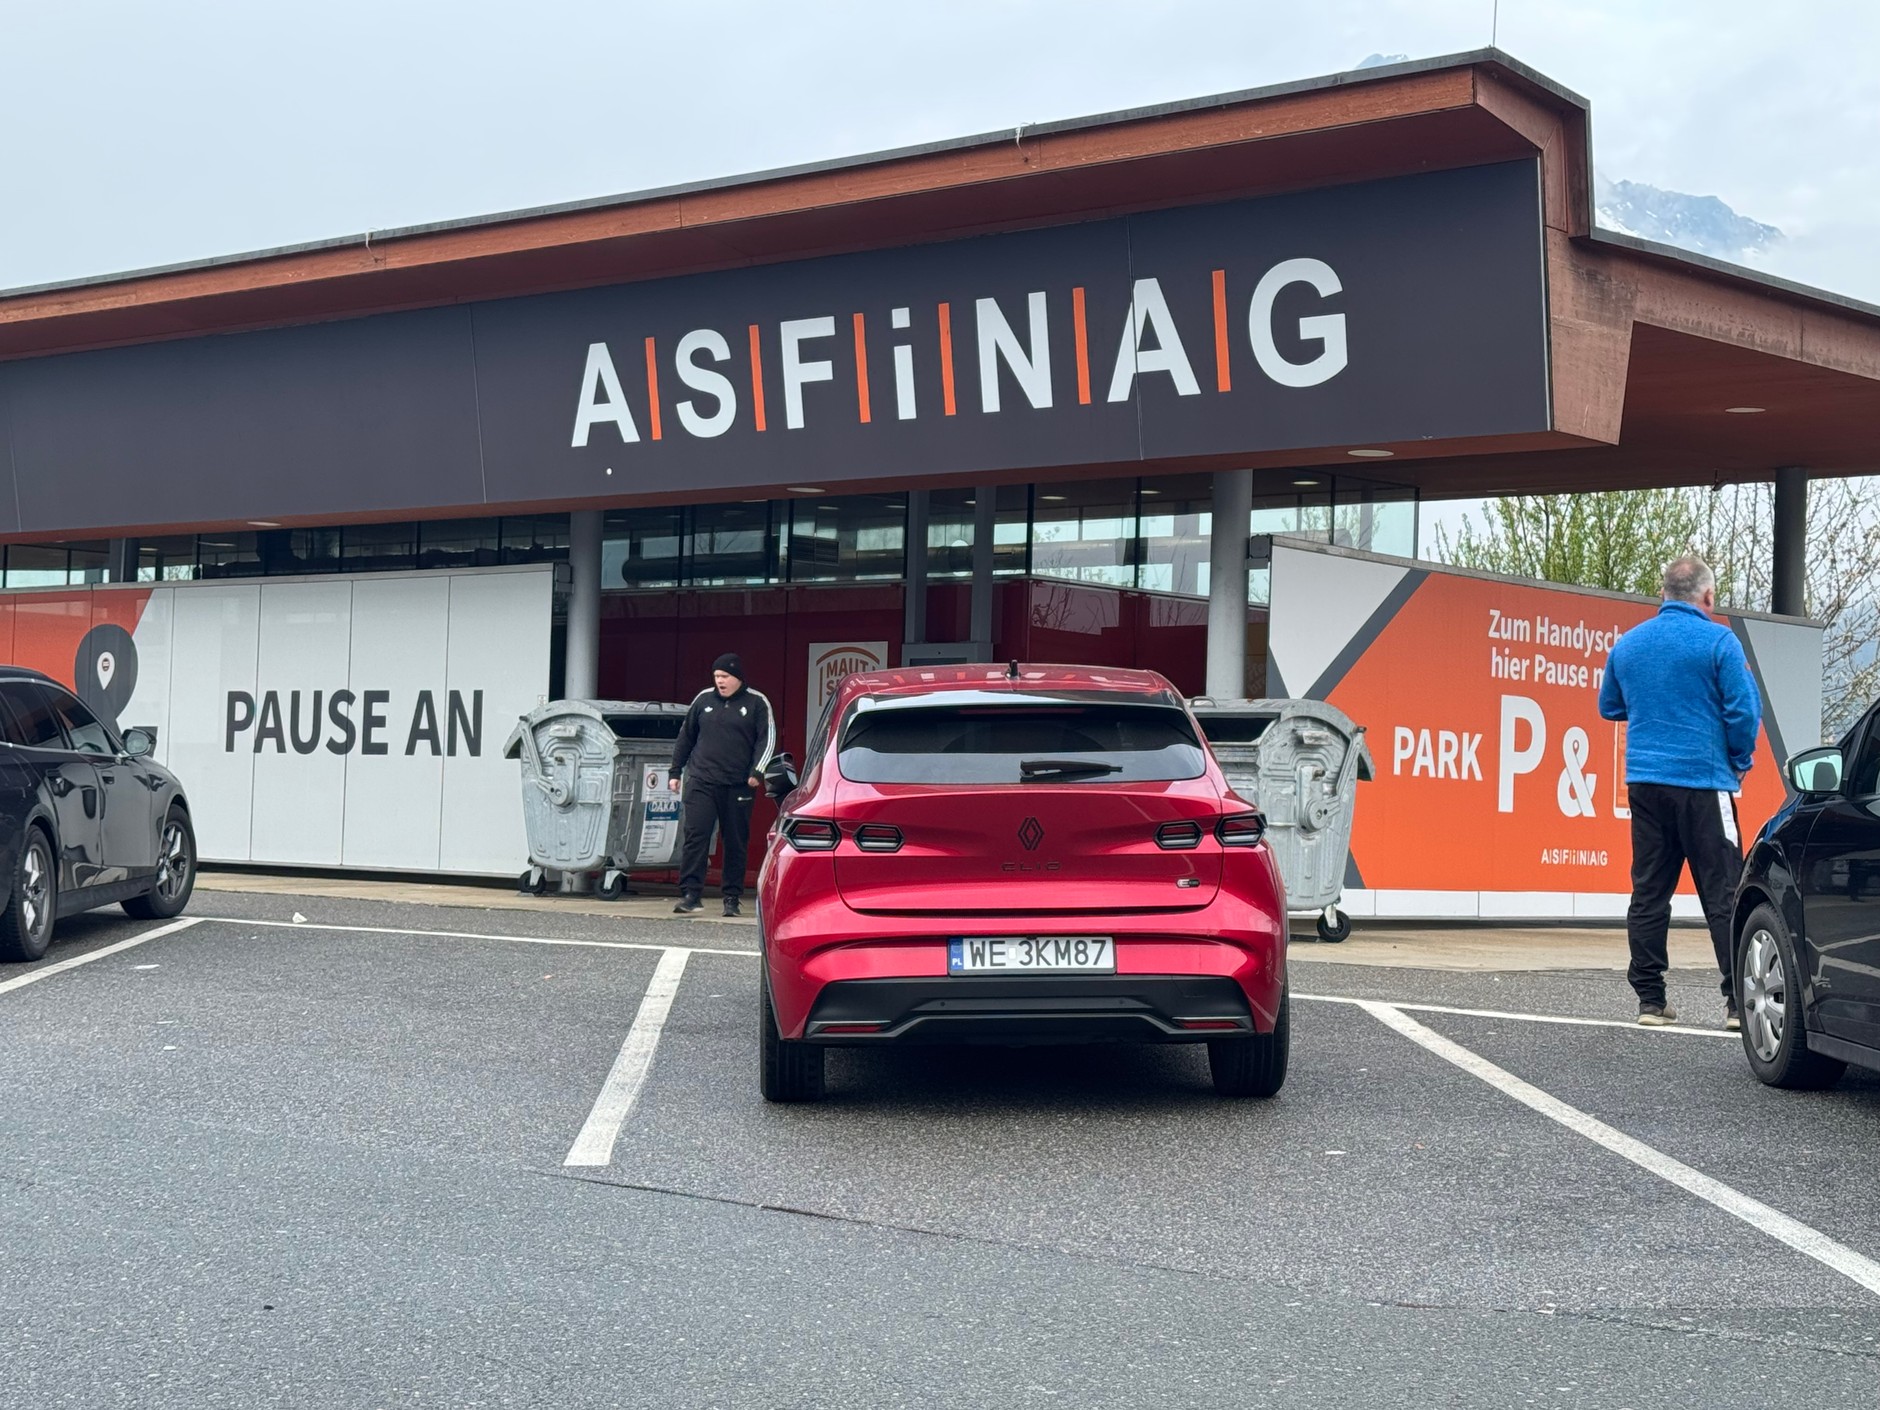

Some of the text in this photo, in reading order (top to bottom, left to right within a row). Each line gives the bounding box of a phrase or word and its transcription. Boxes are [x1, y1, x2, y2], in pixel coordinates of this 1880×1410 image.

[1488, 609, 1623, 658] Zum Handysch
[826, 657, 869, 678] MAUT
[1491, 647, 1530, 681] hier
[1534, 654, 1589, 689] Pause
[225, 689, 390, 755] PAUSE
[404, 689, 484, 757] AN
[1393, 694, 1597, 818] PARK P &
[952, 957, 963, 966] PL
[969, 939, 1107, 967] WE 3KM87
